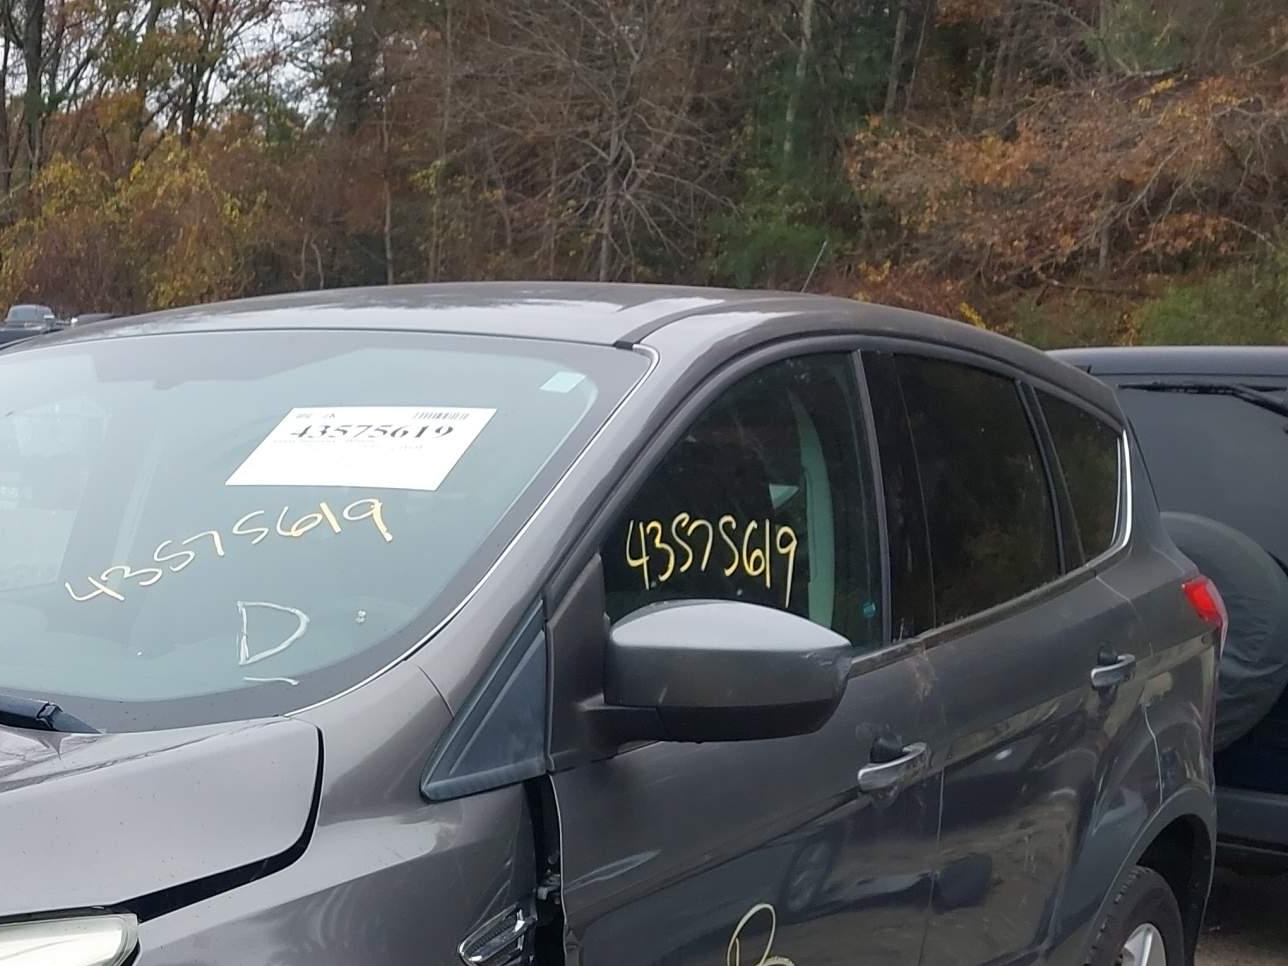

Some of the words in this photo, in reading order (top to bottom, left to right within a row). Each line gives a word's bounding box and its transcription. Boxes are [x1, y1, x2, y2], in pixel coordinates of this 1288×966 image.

[290, 424, 454, 439] 43575619
[65, 498, 393, 602] 43575619
[626, 512, 798, 608] 43575619
[236, 601, 311, 666] D
